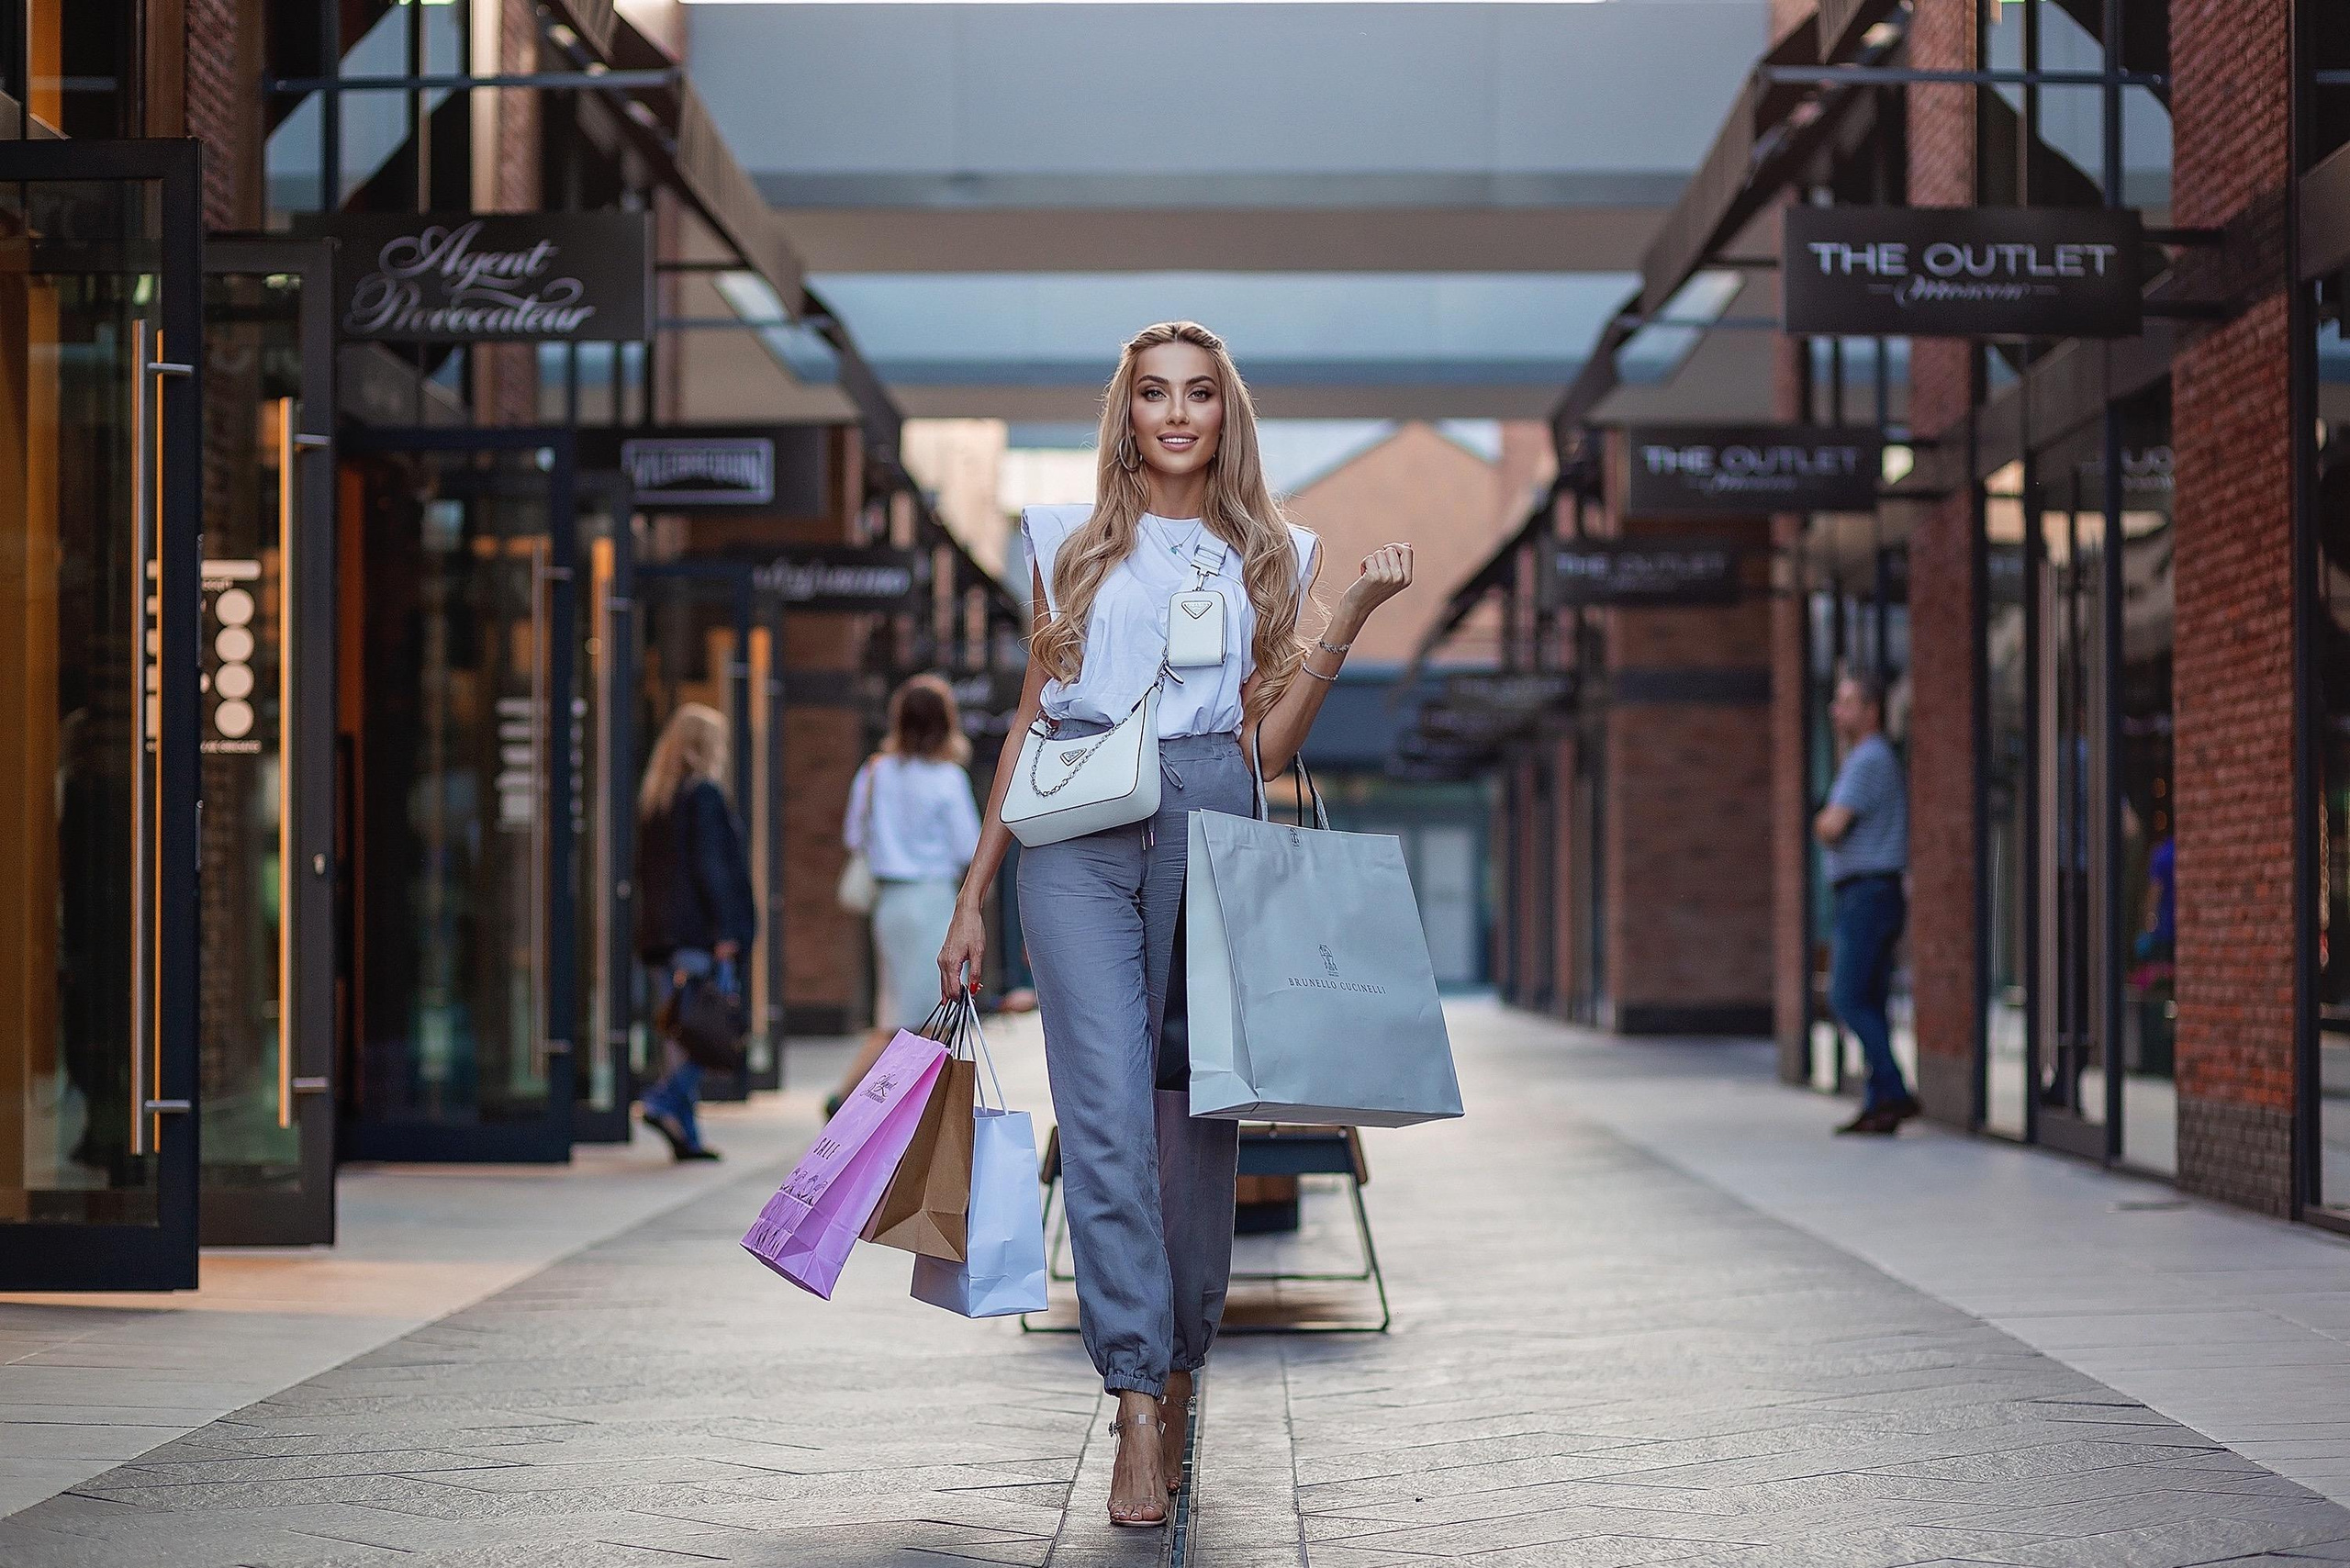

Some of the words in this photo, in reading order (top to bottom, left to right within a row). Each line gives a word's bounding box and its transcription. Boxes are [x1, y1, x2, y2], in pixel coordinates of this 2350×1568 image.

[378, 220, 558, 295] Agent
[1808, 241, 1908, 276] THE
[1922, 241, 2117, 277] OUTLET
[1642, 444, 1715, 476] THE
[1720, 444, 1859, 477] OUTLET
[1288, 977, 1337, 990] BRUNELLO
[1339, 981, 1386, 994] CUCINELLI
[813, 1137, 841, 1160] SALE
